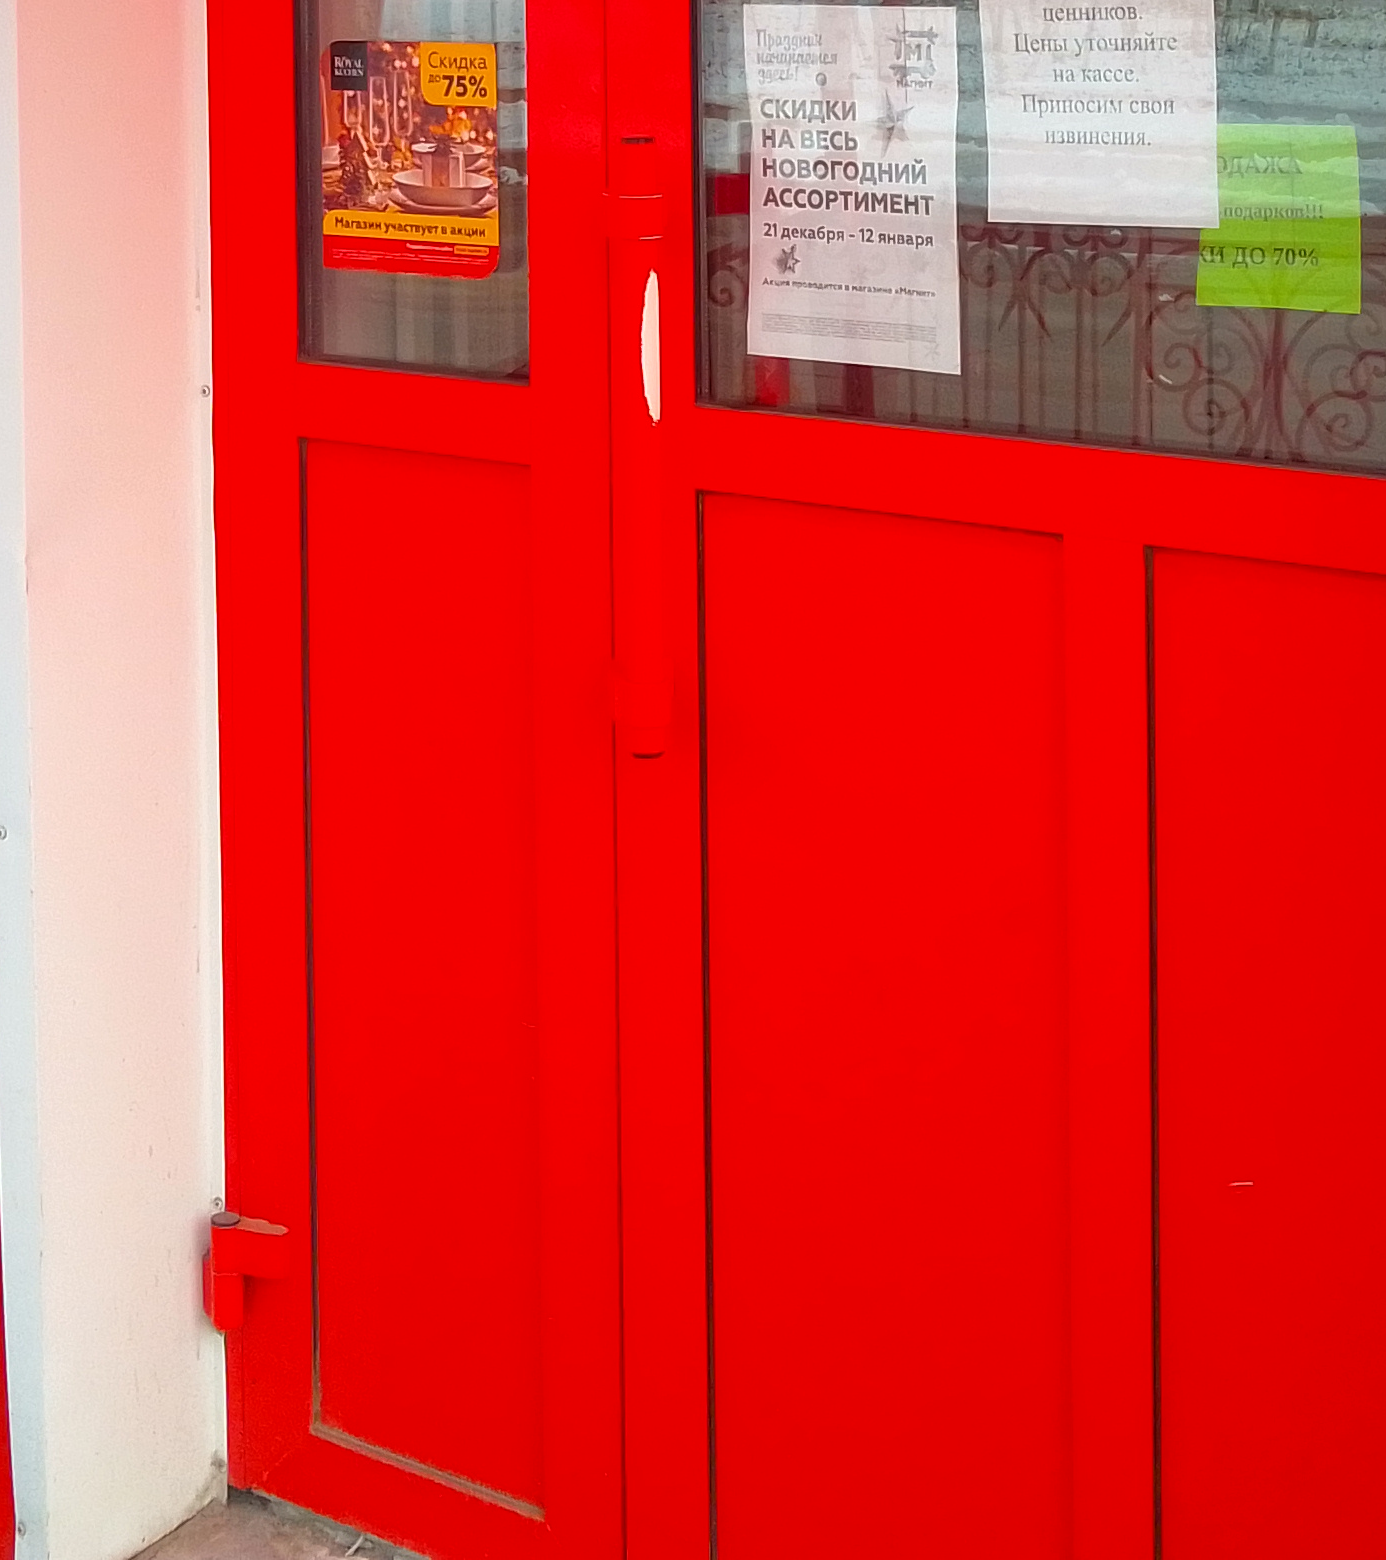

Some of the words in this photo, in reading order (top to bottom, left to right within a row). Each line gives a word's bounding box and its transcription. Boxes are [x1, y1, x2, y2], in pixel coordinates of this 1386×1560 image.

[1043, 6, 1143, 23] ценников.
[1014, 33, 1068, 54] Цены
[1074, 32, 1178, 57] уточняйте
[427, 51, 488, 73] Скидка
[427, 74, 441, 84] до
[441, 75, 488, 99] 75%
[1053, 68, 1075, 83] на
[1082, 68, 1140, 83] кассе.
[760, 98, 858, 123] СКИДКИ
[1022, 94, 1123, 118] Приносим
[1129, 100, 1175, 114] свои
[761, 128, 796, 150] НА
[800, 129, 859, 152] ВЕСЬ
[1045, 130, 1152, 146] извинения.
[762, 157, 928, 186] НОВОГОДНИЙ
[763, 187, 935, 216] АССОРТИМЕНТ
[1224, 203, 1324, 222] подарков!!!
[335, 216, 382, 230] Магазин
[384, 222, 439, 236] участвует
[441, 226, 448, 235] в
[450, 227, 486, 238] акции
[763, 223, 778, 238] 21
[781, 226, 845, 244] декабря
[858, 228, 874, 243] 12
[878, 232, 934, 249] января
[1232, 246, 1266, 269] ДО
[1273, 248, 1319, 267] 70%
